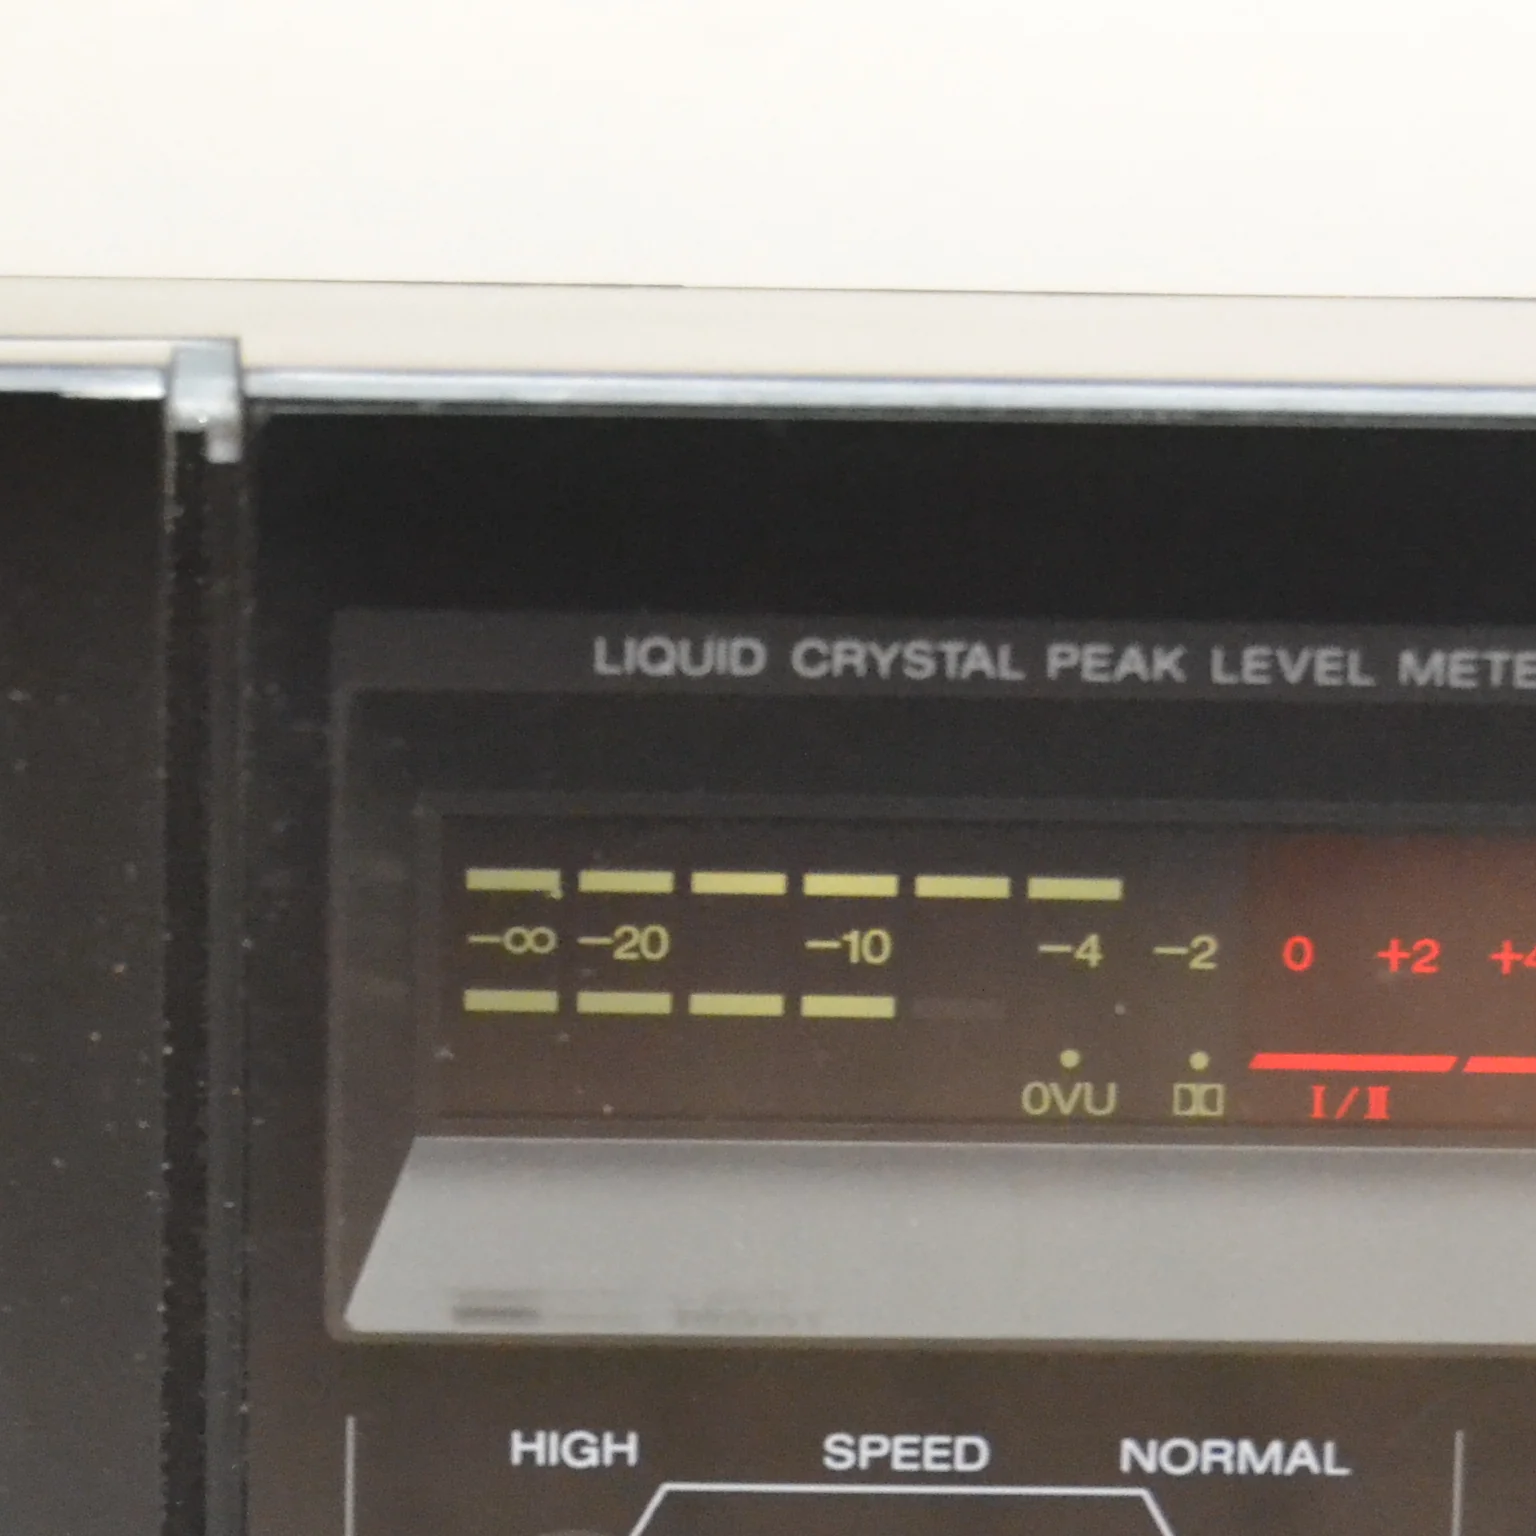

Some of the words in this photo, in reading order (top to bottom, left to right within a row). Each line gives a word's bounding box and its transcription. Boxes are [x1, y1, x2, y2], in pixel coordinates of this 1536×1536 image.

[593, 636, 766, 677] LIQUID
[791, 637, 1025, 681] CRYSTAL
[1046, 641, 1187, 683] PEAK
[1210, 644, 1375, 687] LEVEL
[578, 924, 670, 961] -20
[805, 928, 893, 965] -10
[1037, 933, 1104, 968] -4
[1153, 934, 1220, 970] -2
[1376, 938, 1442, 974] +2
[510, 1430, 639, 1468] HIGH
[822, 1433, 991, 1472] SPEED
[1119, 1437, 1351, 1476] NORMAL
